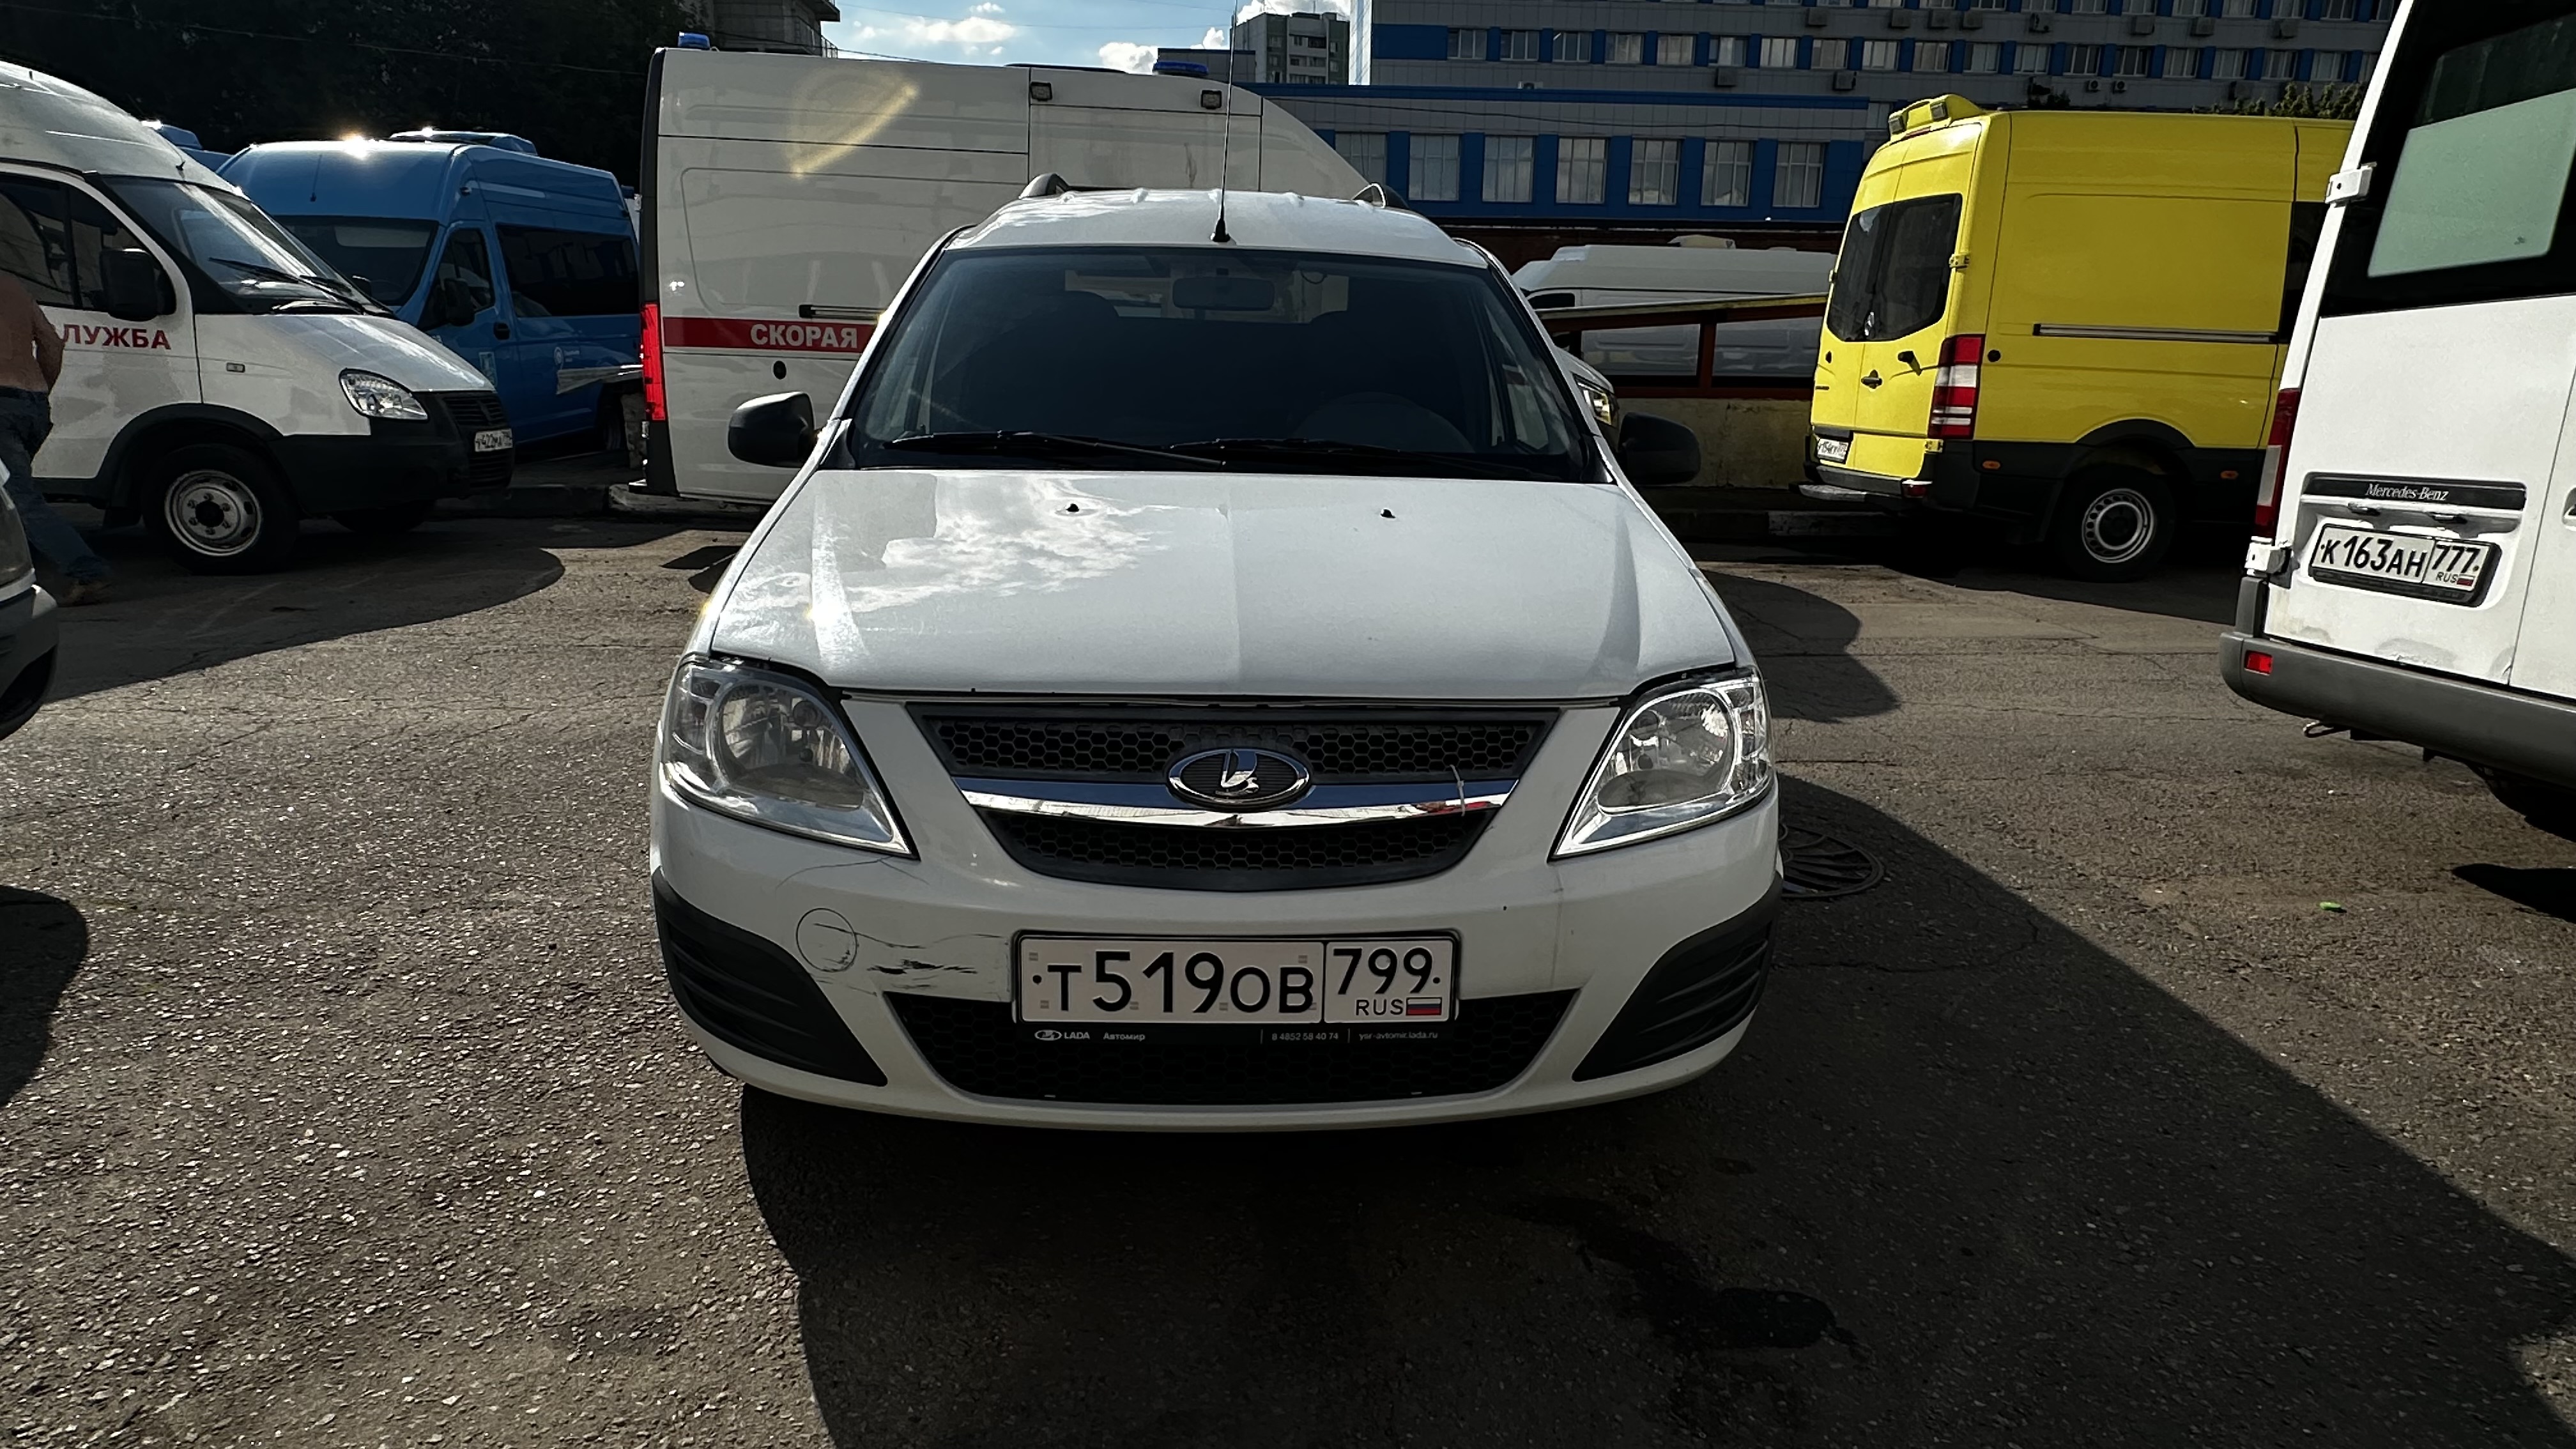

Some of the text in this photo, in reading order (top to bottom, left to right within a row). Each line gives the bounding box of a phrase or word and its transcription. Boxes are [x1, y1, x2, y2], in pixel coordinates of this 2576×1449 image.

[62, 323, 171, 349] ЛУЖБА
[750, 323, 857, 349] СКОРАЯ
[2365, 483, 2450, 501] Mercedes-Benz
[2432, 544, 2481, 574] 777
[2435, 571, 2458, 583] RUS
[1046, 947, 1433, 1013] Т519ОВ 799
[1356, 999, 1404, 1016] RUS
[1103, 1032, 1146, 1041] Автомир
